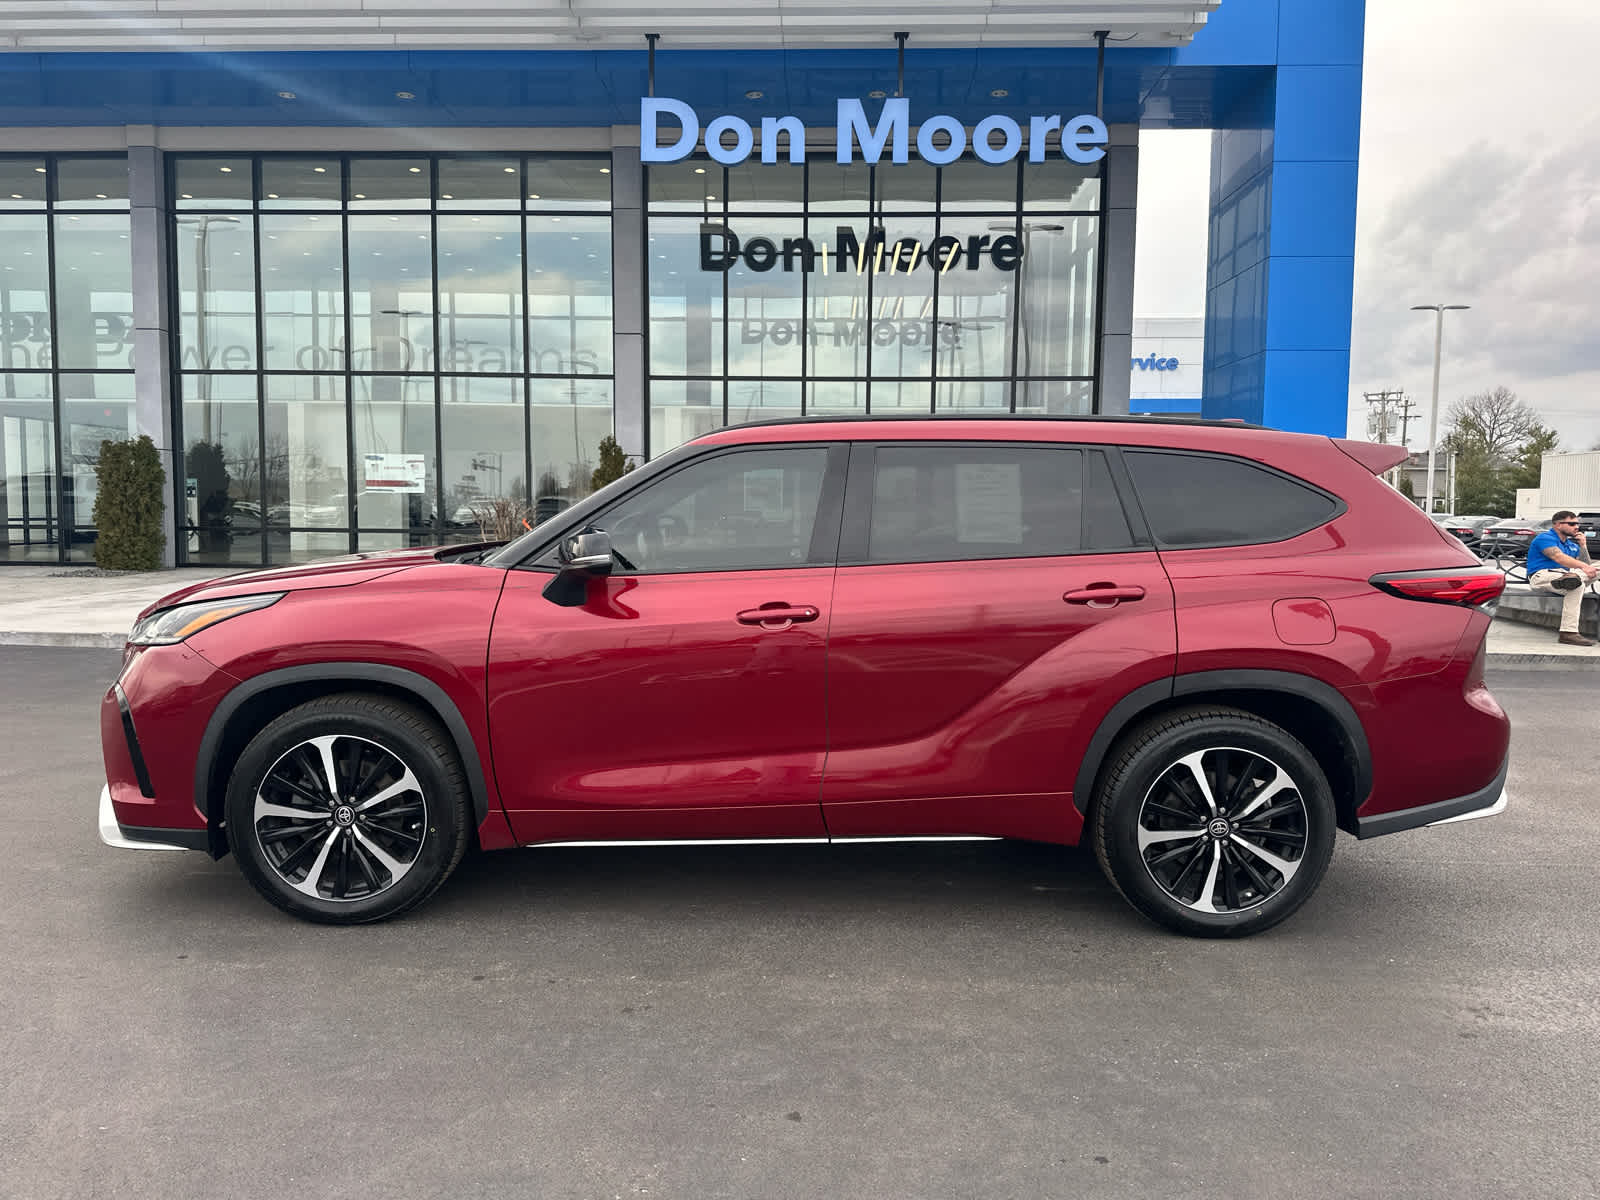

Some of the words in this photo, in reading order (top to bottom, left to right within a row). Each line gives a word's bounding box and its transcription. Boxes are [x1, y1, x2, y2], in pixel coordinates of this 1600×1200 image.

[640, 96, 806, 167] Don
[836, 97, 1110, 167] Moore
[700, 222, 816, 273] Don
[835, 224, 1024, 273] Moore
